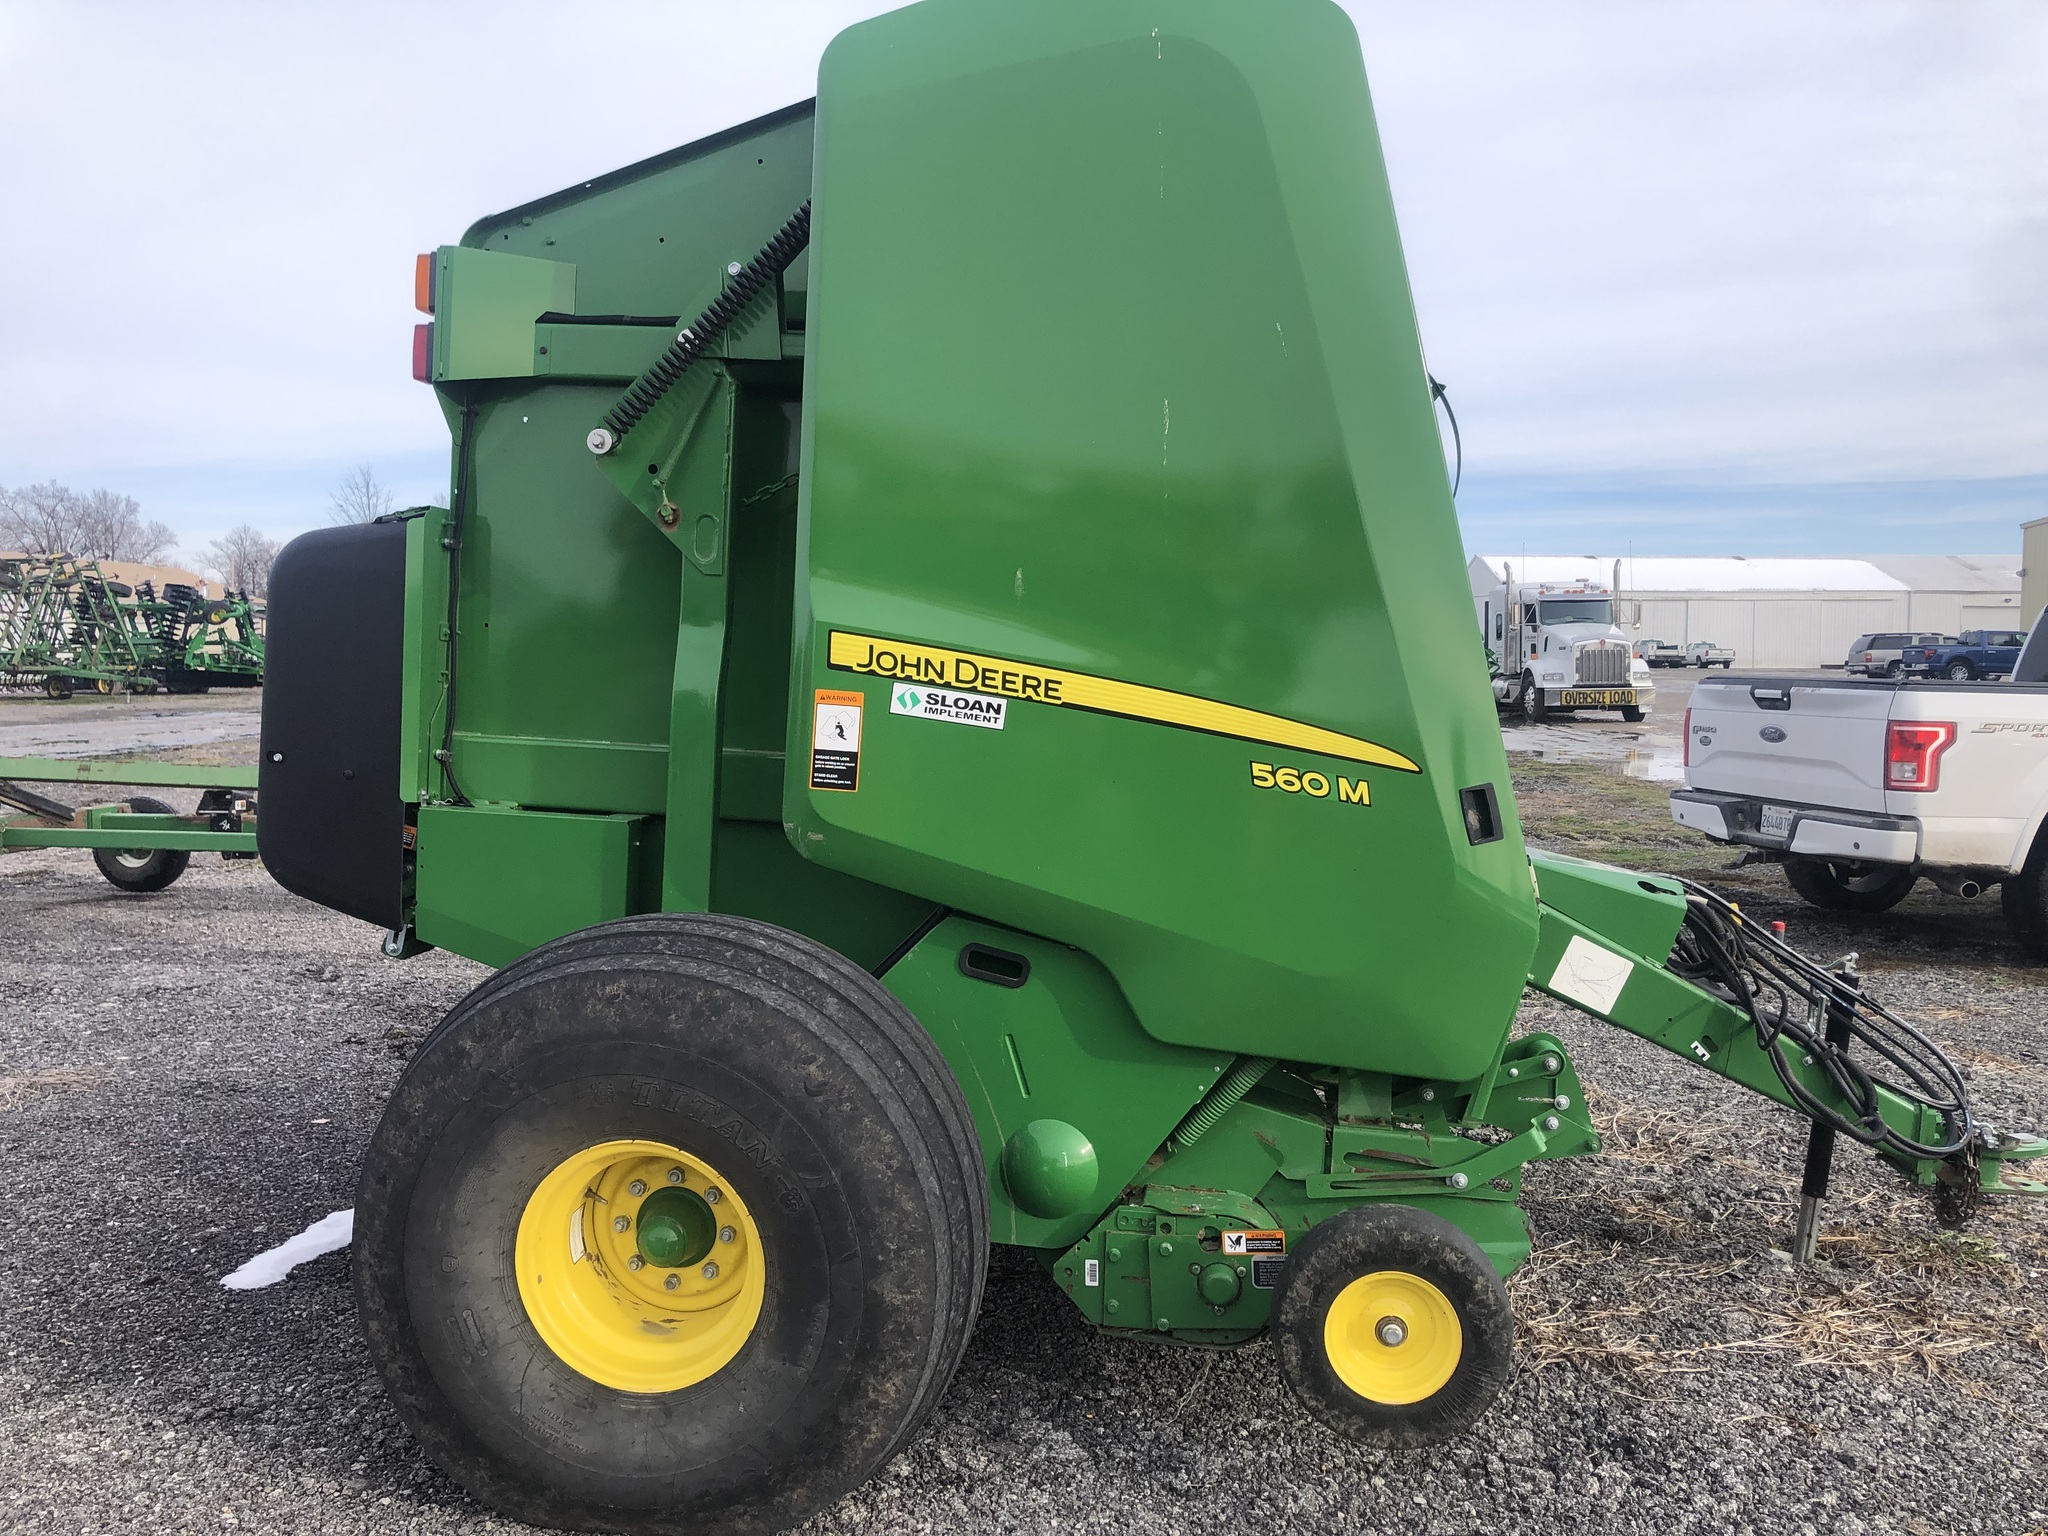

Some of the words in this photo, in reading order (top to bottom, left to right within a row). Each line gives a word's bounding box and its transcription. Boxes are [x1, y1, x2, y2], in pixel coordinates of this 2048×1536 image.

[856, 644, 945, 680] JOHN
[954, 657, 1062, 701] DEERE
[825, 694, 857, 703] WARNING
[925, 692, 1002, 716] SLOAN
[1565, 691, 1607, 705] OVERSIZE
[1609, 690, 1633, 704] LOAD
[924, 706, 1000, 725] IMPLEMENT
[1249, 760, 1332, 798] 560
[1336, 775, 1371, 807] M
[631, 1078, 785, 1170] TITAN
